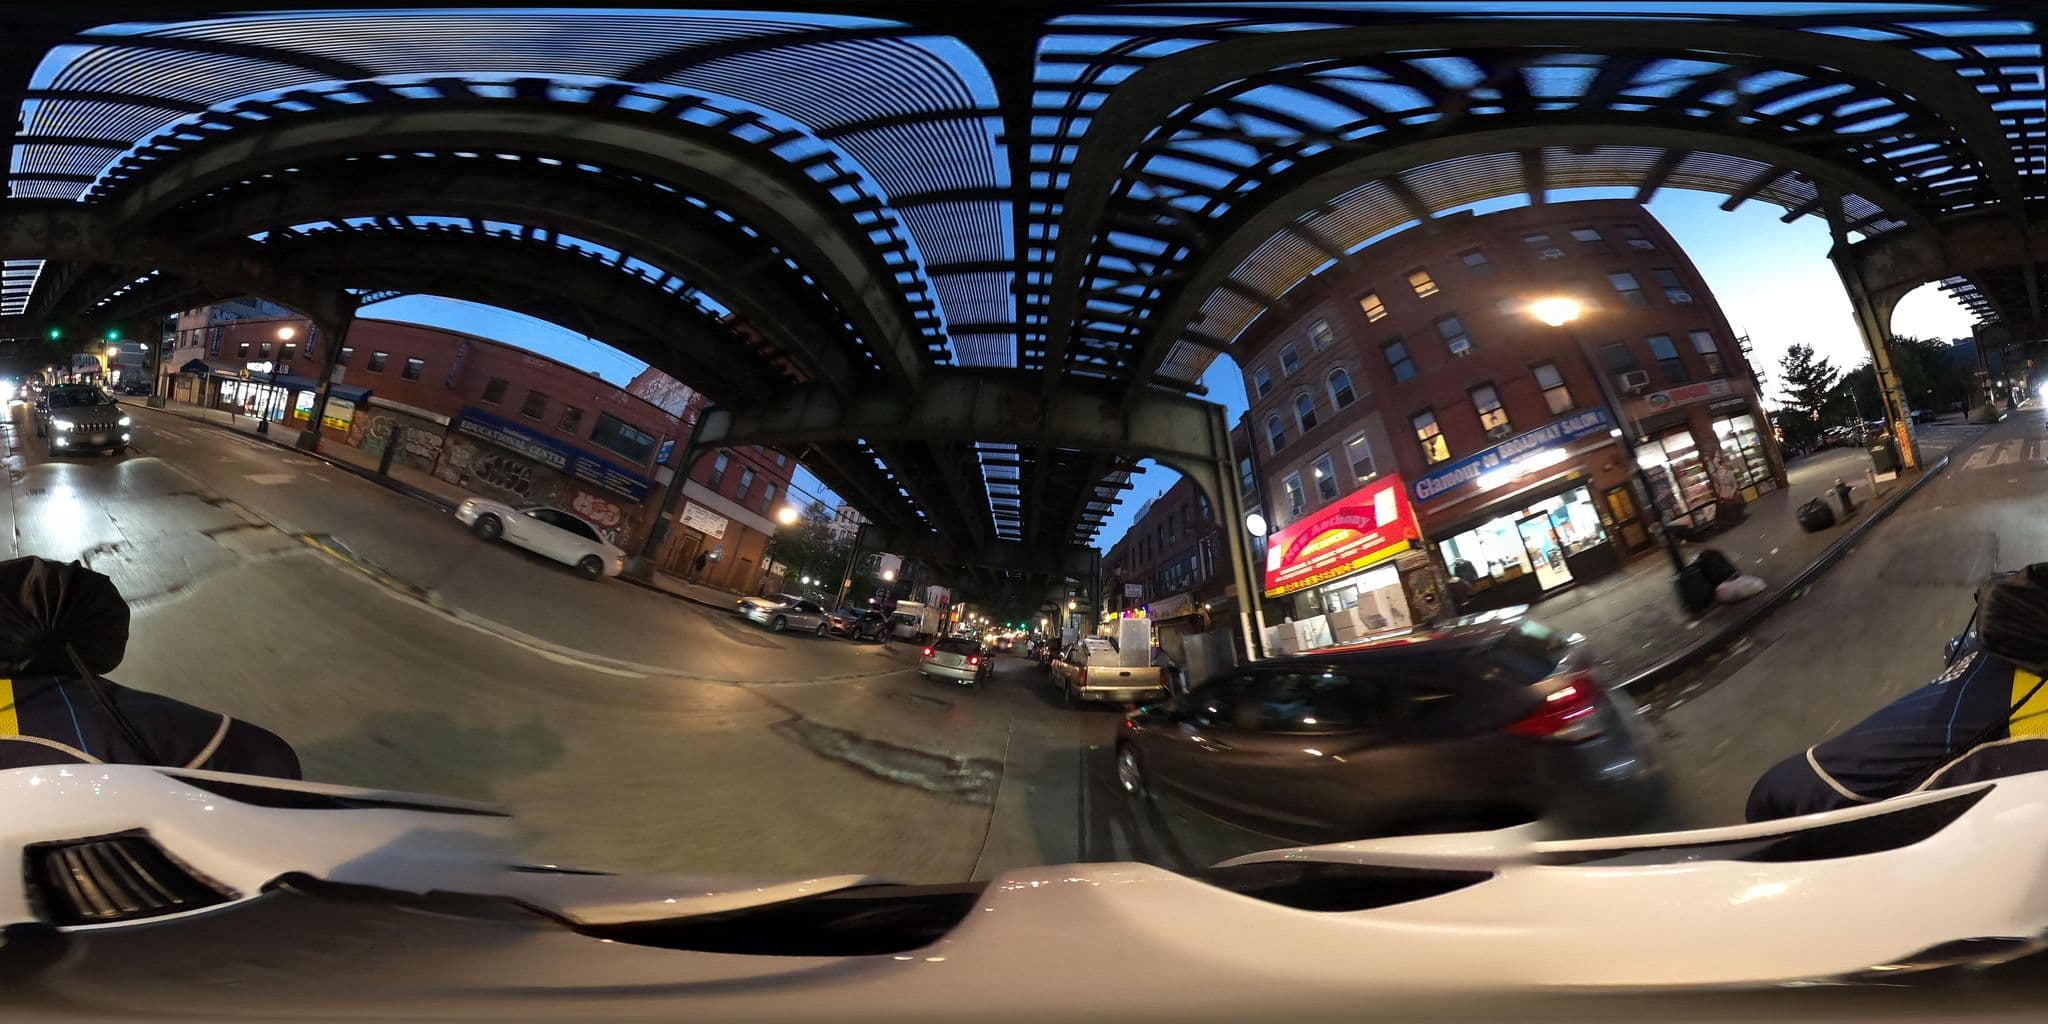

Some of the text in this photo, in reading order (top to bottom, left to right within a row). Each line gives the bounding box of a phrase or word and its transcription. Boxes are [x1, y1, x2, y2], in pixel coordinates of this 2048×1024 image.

[459, 420, 525, 450] EDUCATIONAL
[527, 444, 567, 467] CENTER
[1415, 462, 1482, 499] Glamour
[1560, 411, 1599, 434] SALON
